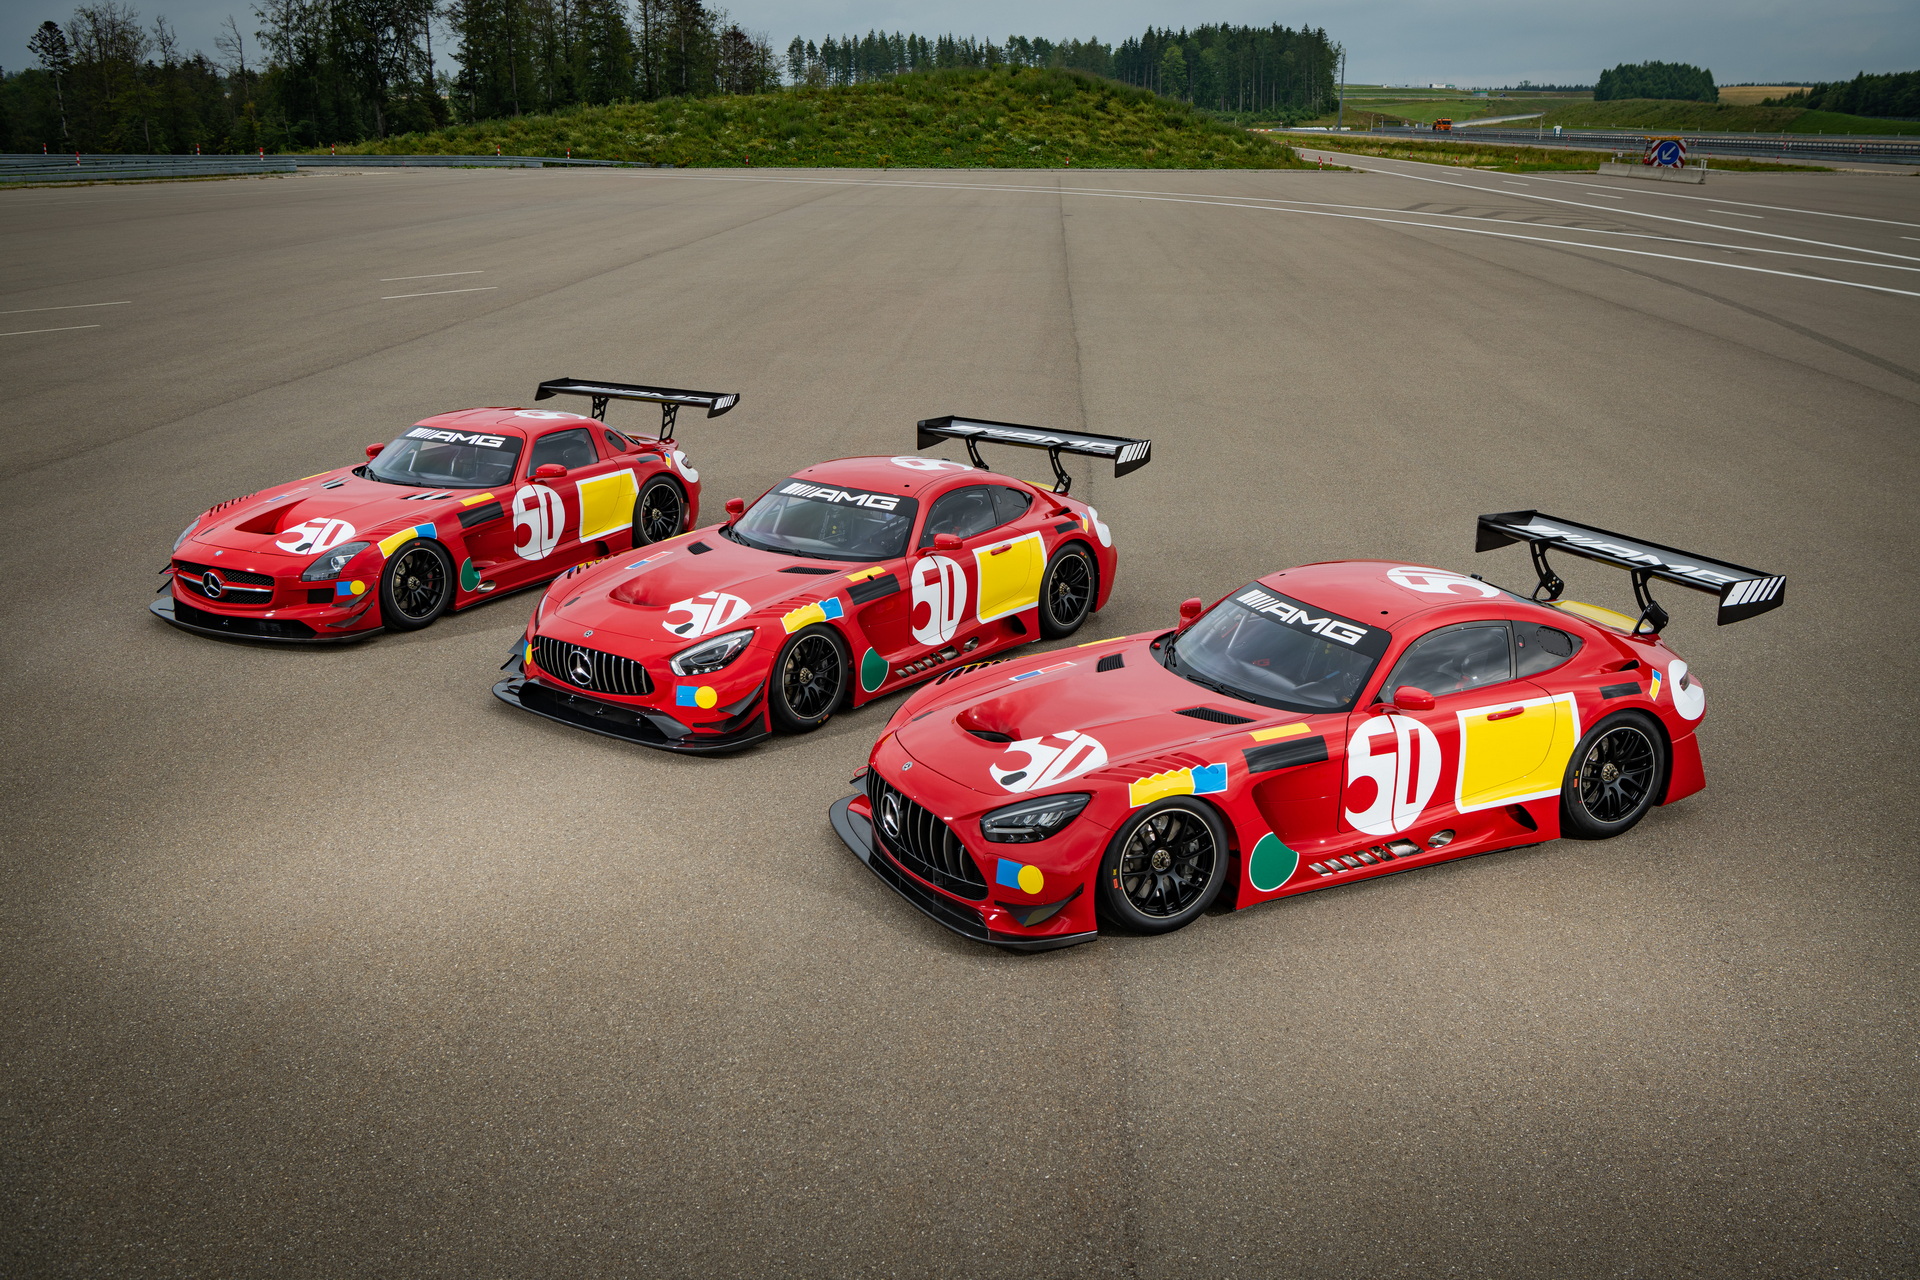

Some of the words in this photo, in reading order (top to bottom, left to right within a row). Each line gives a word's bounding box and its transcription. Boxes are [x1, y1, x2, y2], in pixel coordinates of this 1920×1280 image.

[427, 430, 507, 448] AMG
[512, 484, 566, 561] 50
[808, 487, 901, 511] AMG
[275, 517, 356, 555] 50
[661, 591, 752, 639] 50
[911, 555, 968, 646] 50
[1263, 601, 1369, 646] AMG
[988, 729, 1109, 794] 50
[1344, 714, 1442, 836] 50
